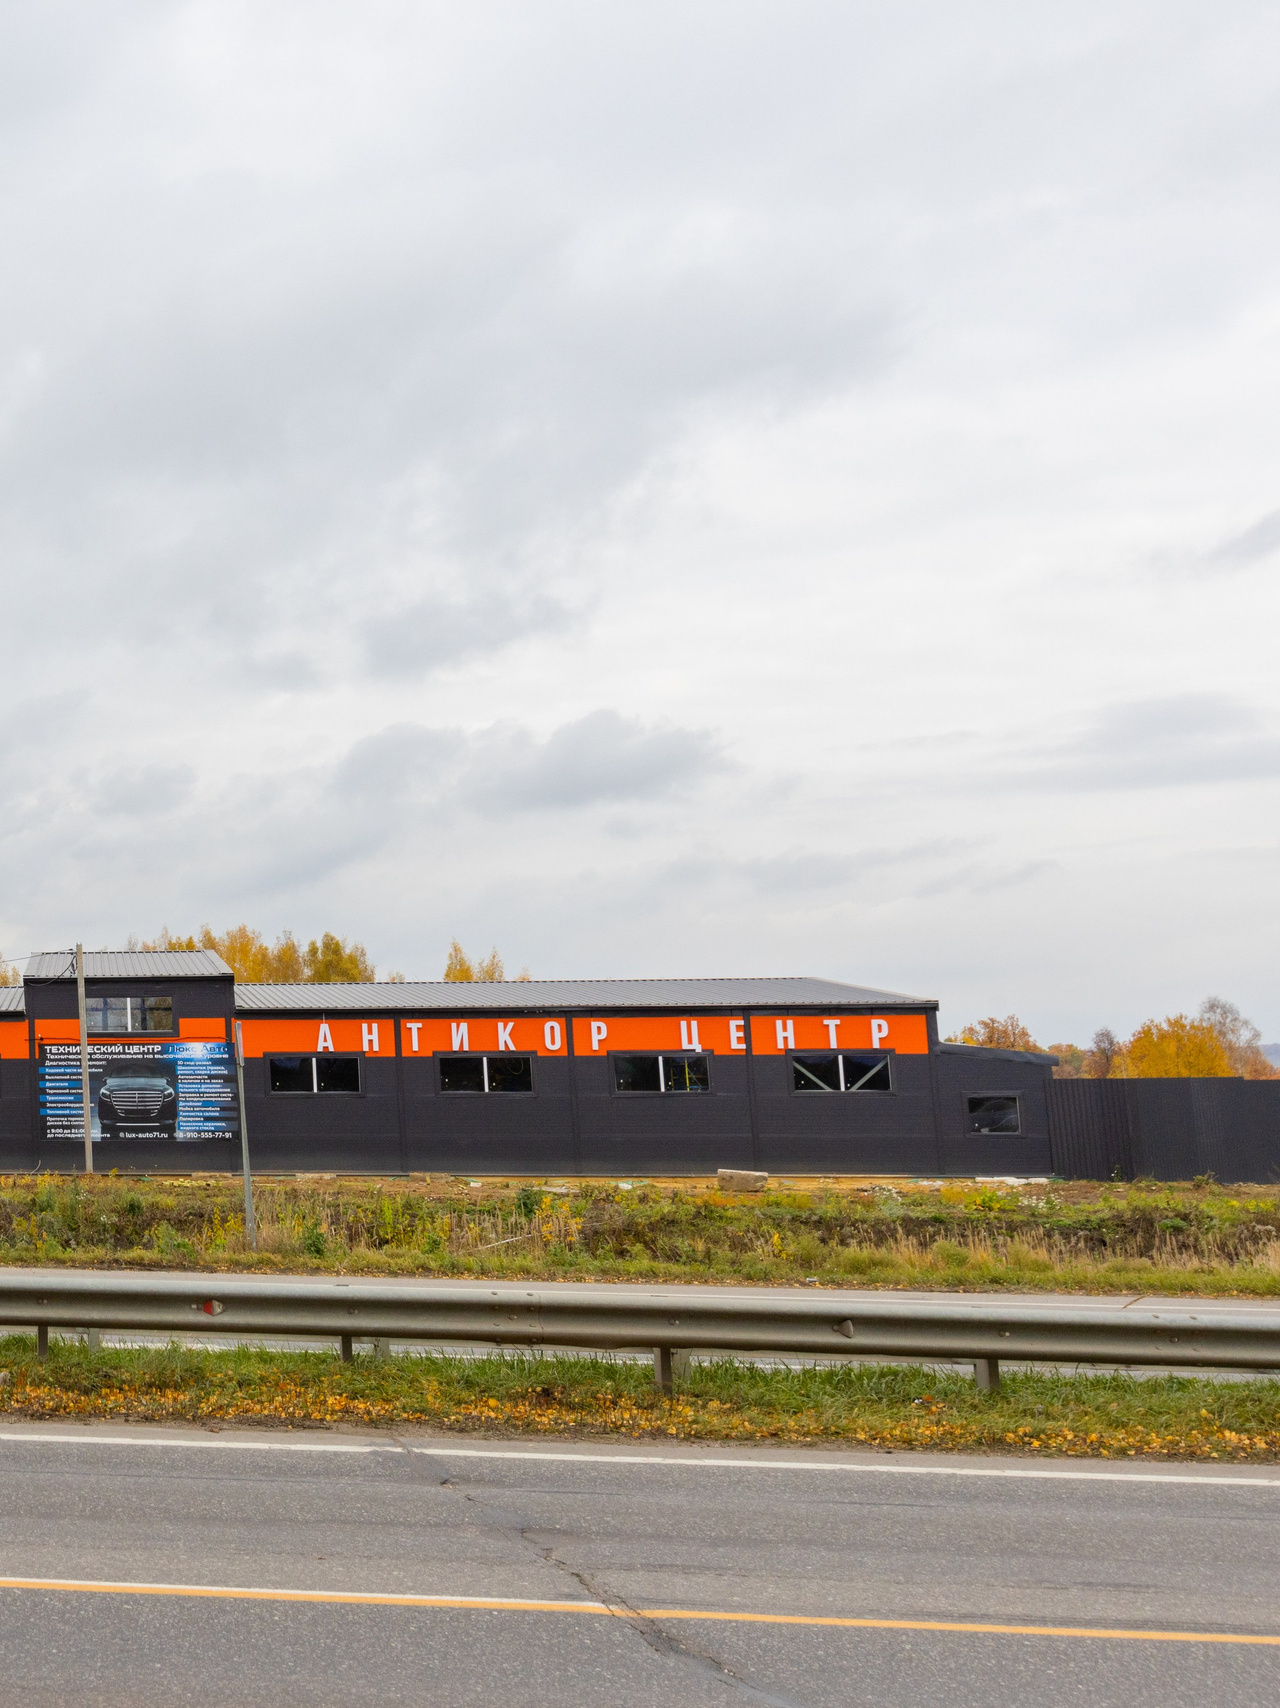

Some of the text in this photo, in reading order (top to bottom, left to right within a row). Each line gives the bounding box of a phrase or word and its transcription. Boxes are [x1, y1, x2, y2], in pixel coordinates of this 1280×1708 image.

[317, 1019, 888, 1052] АНТИКОР ЦЕНТР
[44, 1044, 162, 1054] ТЕХНИЕСКИЙ ЦЕНТР
